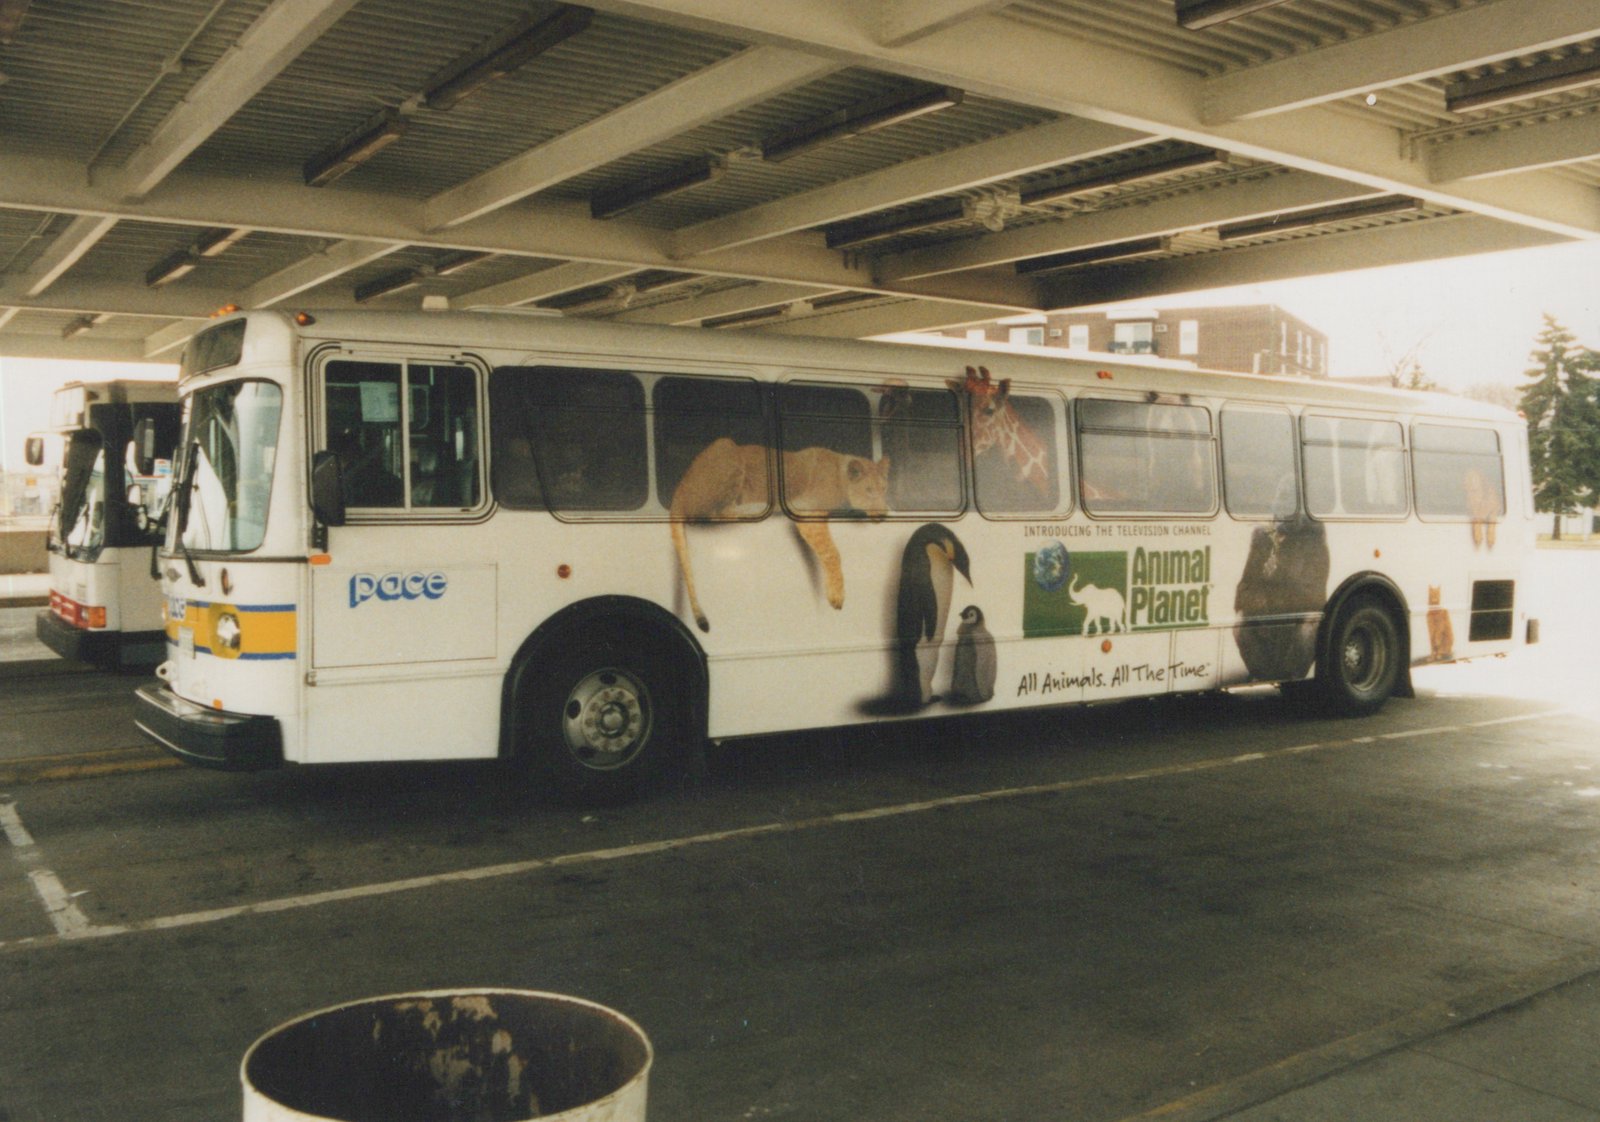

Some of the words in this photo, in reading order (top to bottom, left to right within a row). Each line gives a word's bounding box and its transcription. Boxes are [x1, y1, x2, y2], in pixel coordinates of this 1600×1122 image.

[1024, 525, 1091, 537] INTRODUCING
[1096, 525, 1113, 537] THE
[1117, 525, 1169, 537] TELEVISION
[1172, 525, 1212, 536] CHANNEL
[1132, 545, 1211, 585] Animal
[348, 571, 449, 608] pace
[1130, 585, 1211, 624] Planet
[1017, 672, 1037, 697] All
[1041, 667, 1106, 694] Animals.
[1111, 665, 1129, 687] All
[1132, 664, 1165, 682] The
